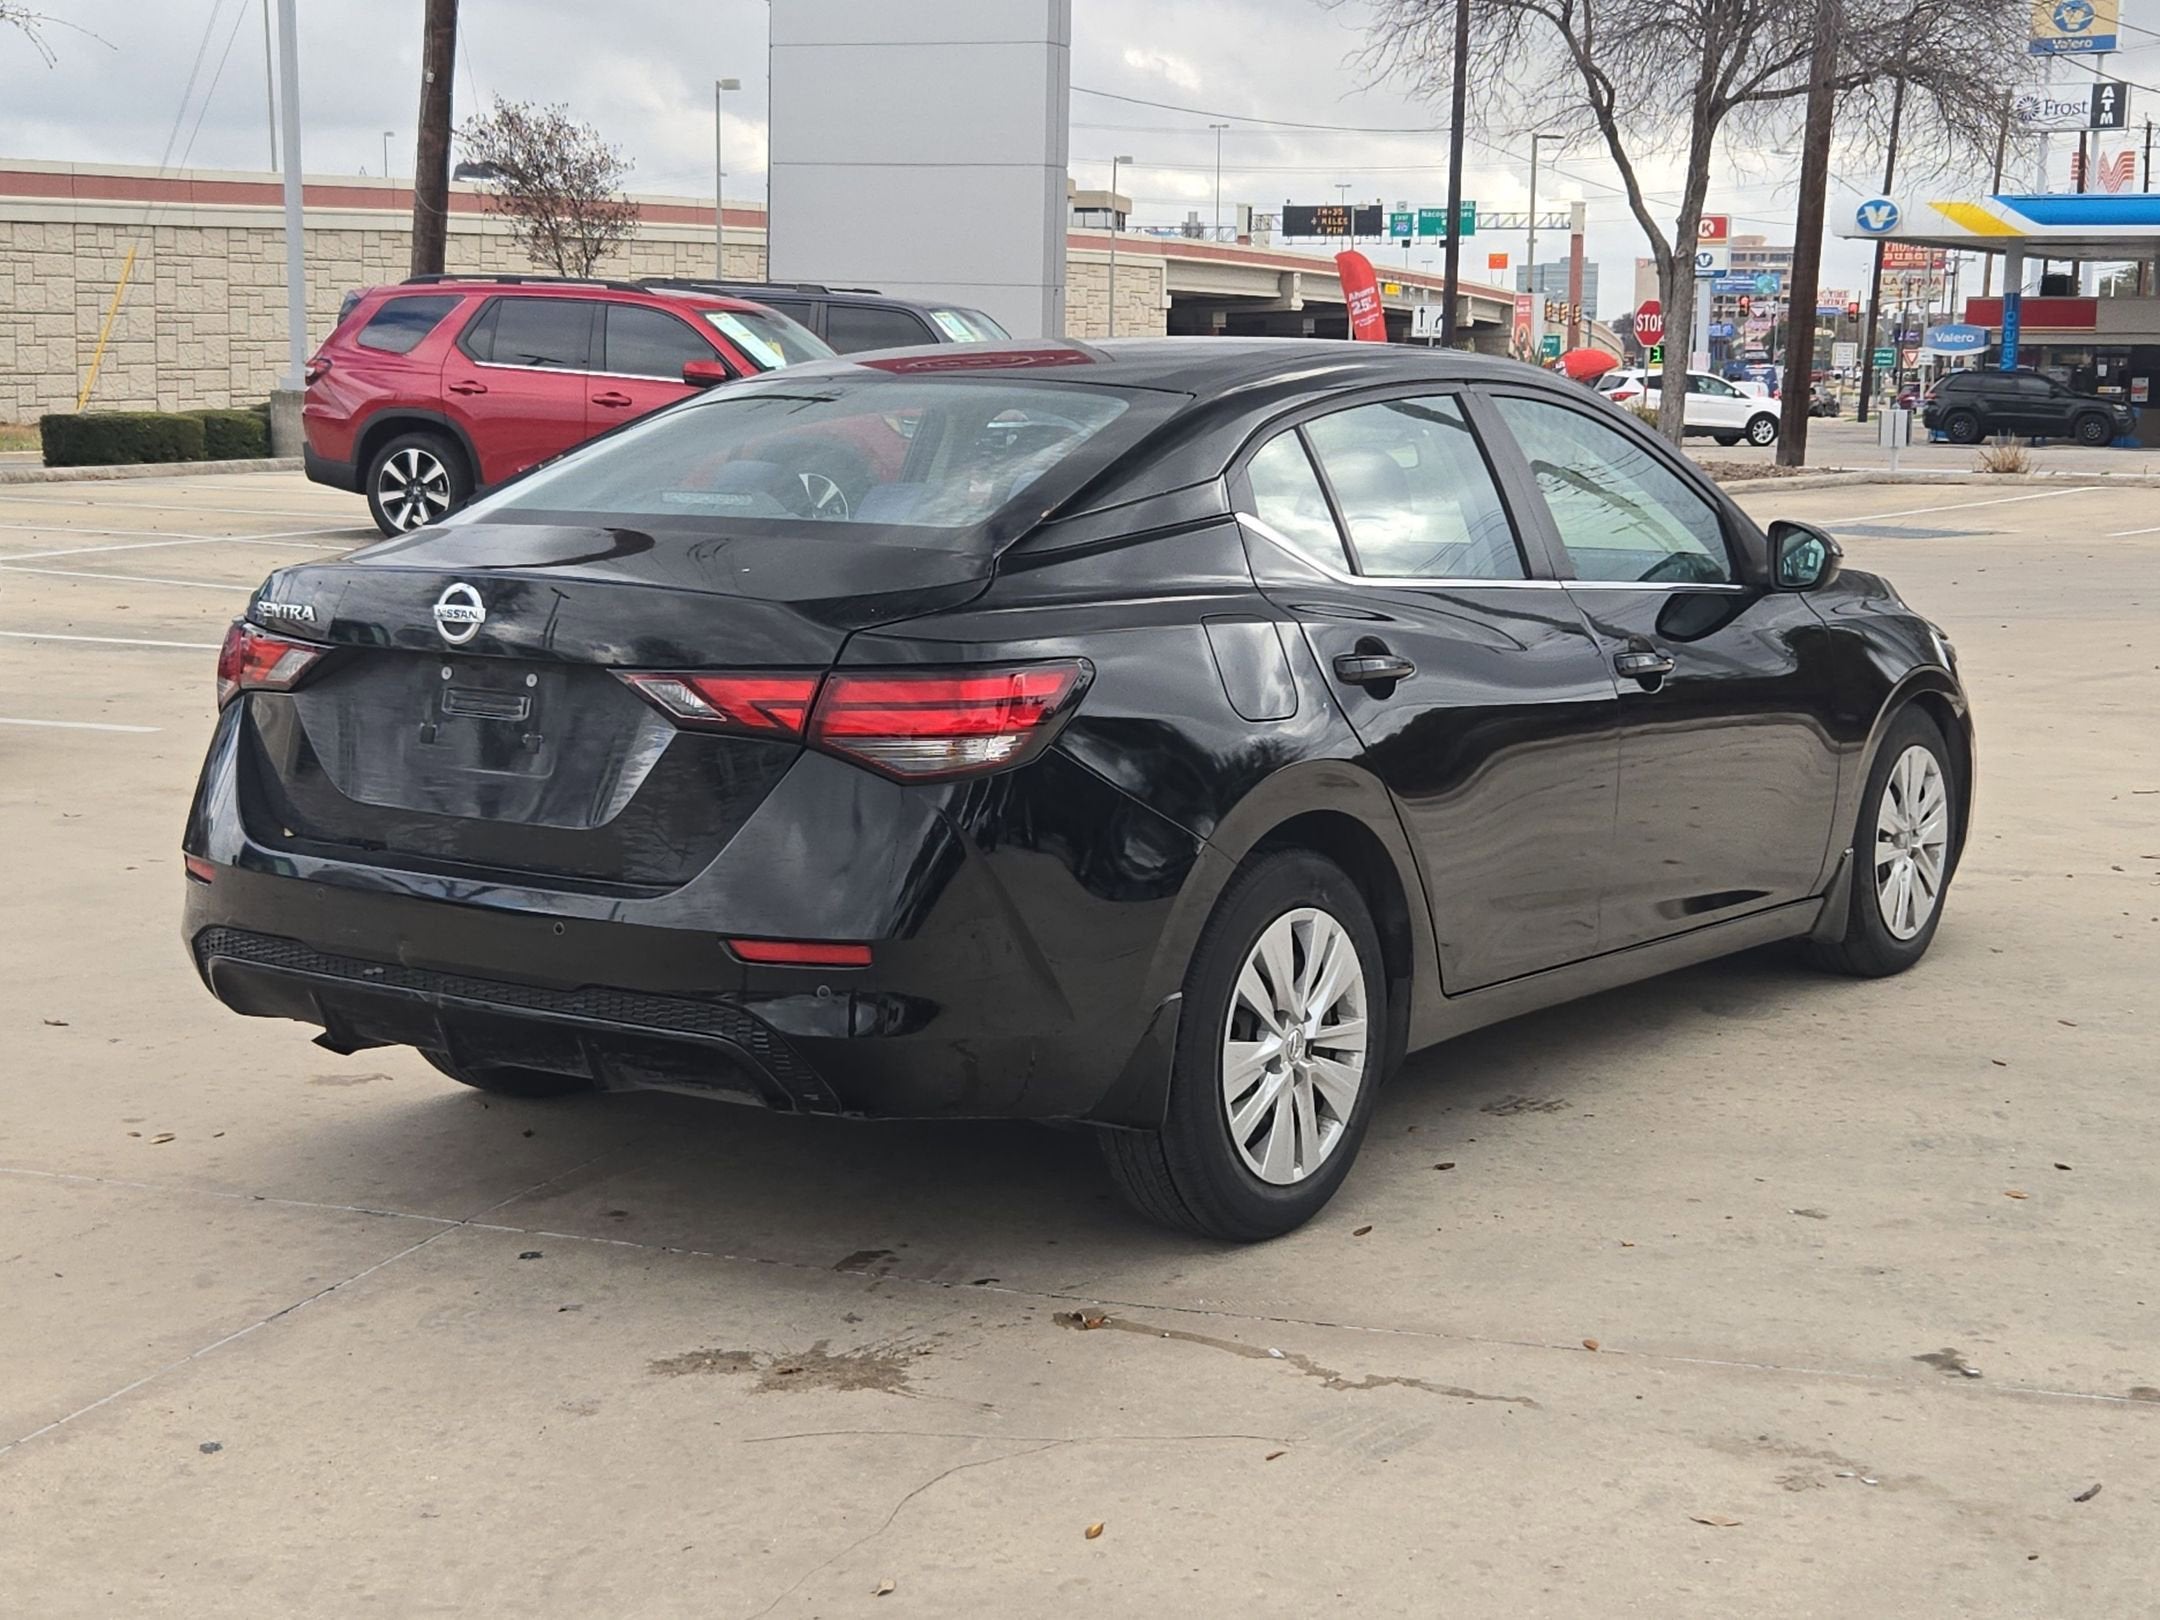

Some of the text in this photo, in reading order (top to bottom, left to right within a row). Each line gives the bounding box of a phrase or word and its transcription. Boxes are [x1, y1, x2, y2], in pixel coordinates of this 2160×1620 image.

[2052, 39, 2093, 49] Valero
[2043, 99, 2088, 116] Frost
[2099, 85, 2115, 125] ATM
[1321, 217, 1348, 225] MILES
[1935, 332, 1975, 343] Valero
[2001, 311, 2016, 370] Valero
[257, 601, 316, 622] SENTRA
[437, 608, 478, 619] NISSAN
